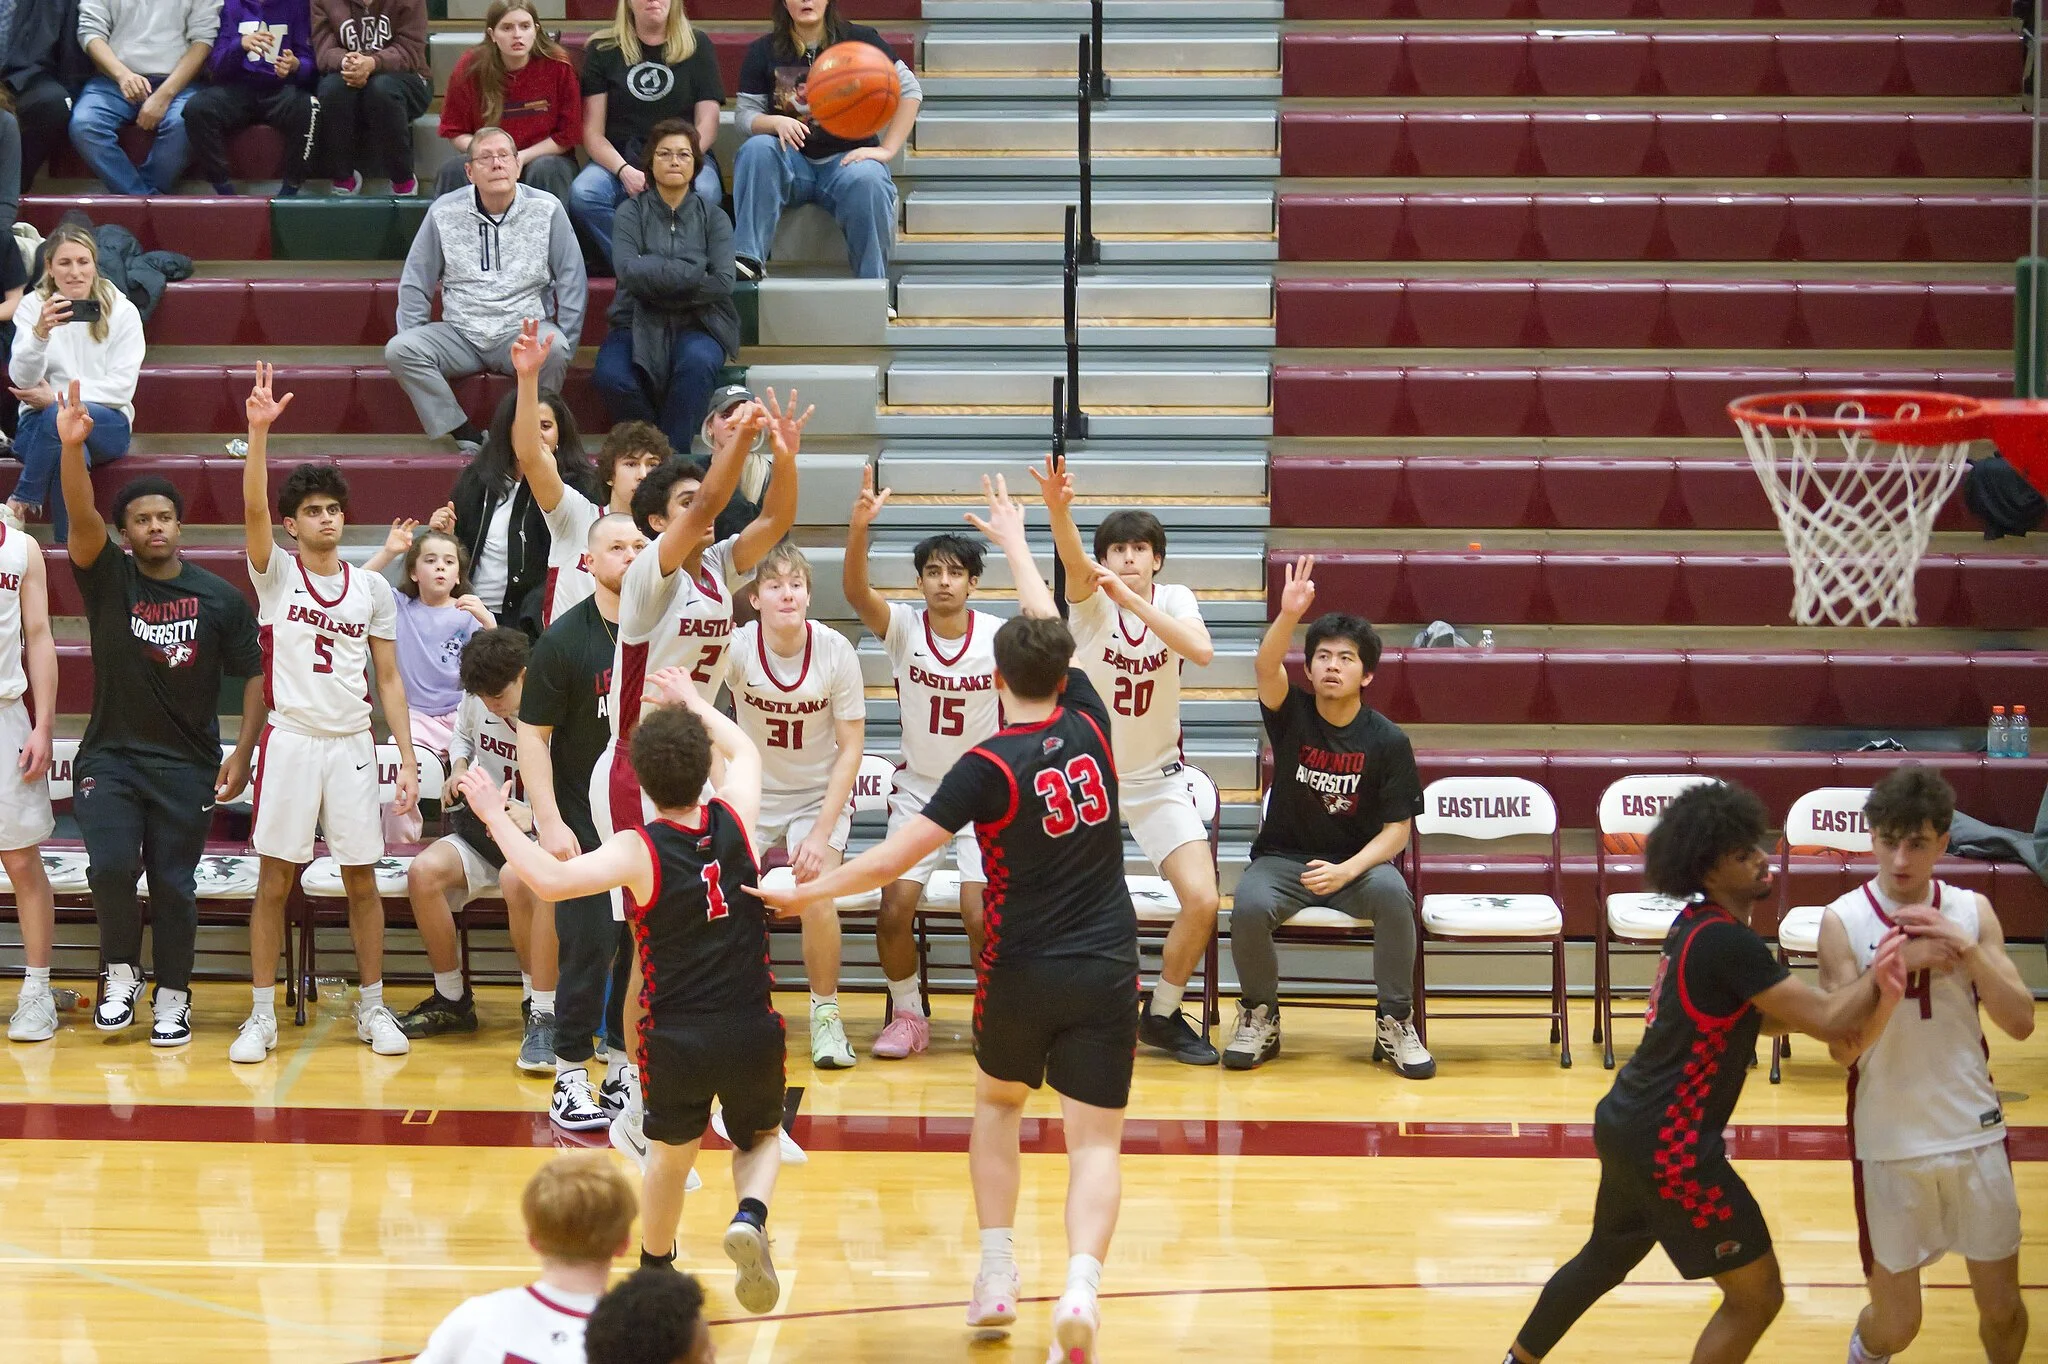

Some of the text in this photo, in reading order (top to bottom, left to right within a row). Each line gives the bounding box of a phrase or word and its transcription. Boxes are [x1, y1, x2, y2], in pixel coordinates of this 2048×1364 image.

[340, 14, 392, 51] GAP
[287, 604, 366, 638] EASTLAKE
[678, 616, 732, 638] EASTL
[313, 634, 335, 674] 5
[690, 643, 730, 684] 2
[909, 665, 992, 692] EASTLAKE
[1113, 676, 1154, 717] 20
[743, 691, 829, 715] EASTLAKE
[929, 695, 965, 737] 15
[766, 717, 804, 750] 31
[1034, 753, 1111, 838] 33
[1437, 796, 1531, 818] EASTLAKE
[701, 859, 729, 922] 1
